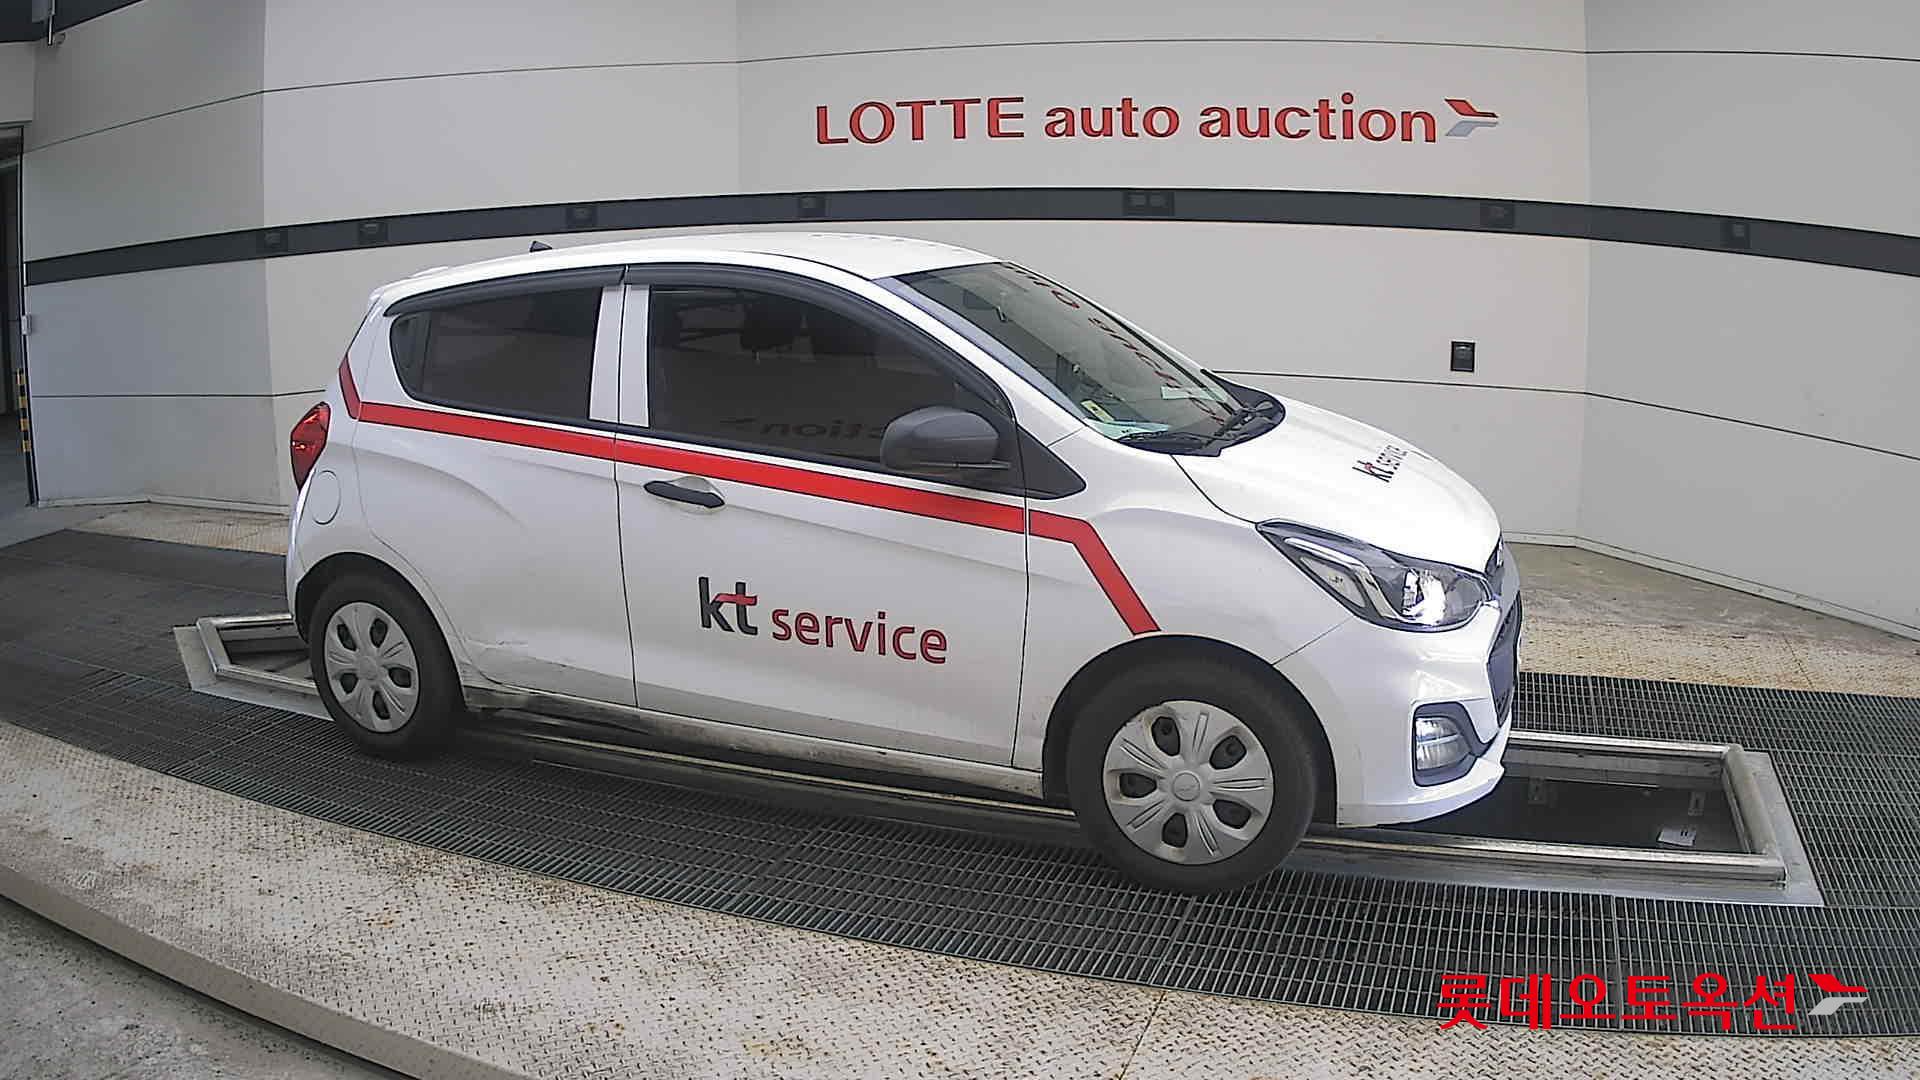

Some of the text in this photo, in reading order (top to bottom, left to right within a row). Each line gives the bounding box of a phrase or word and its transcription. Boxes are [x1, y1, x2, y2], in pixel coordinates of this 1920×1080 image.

[816, 92, 1438, 145] LOTTE auto auction
[1352, 460, 1394, 483] kt
[698, 576, 948, 665] kt service
